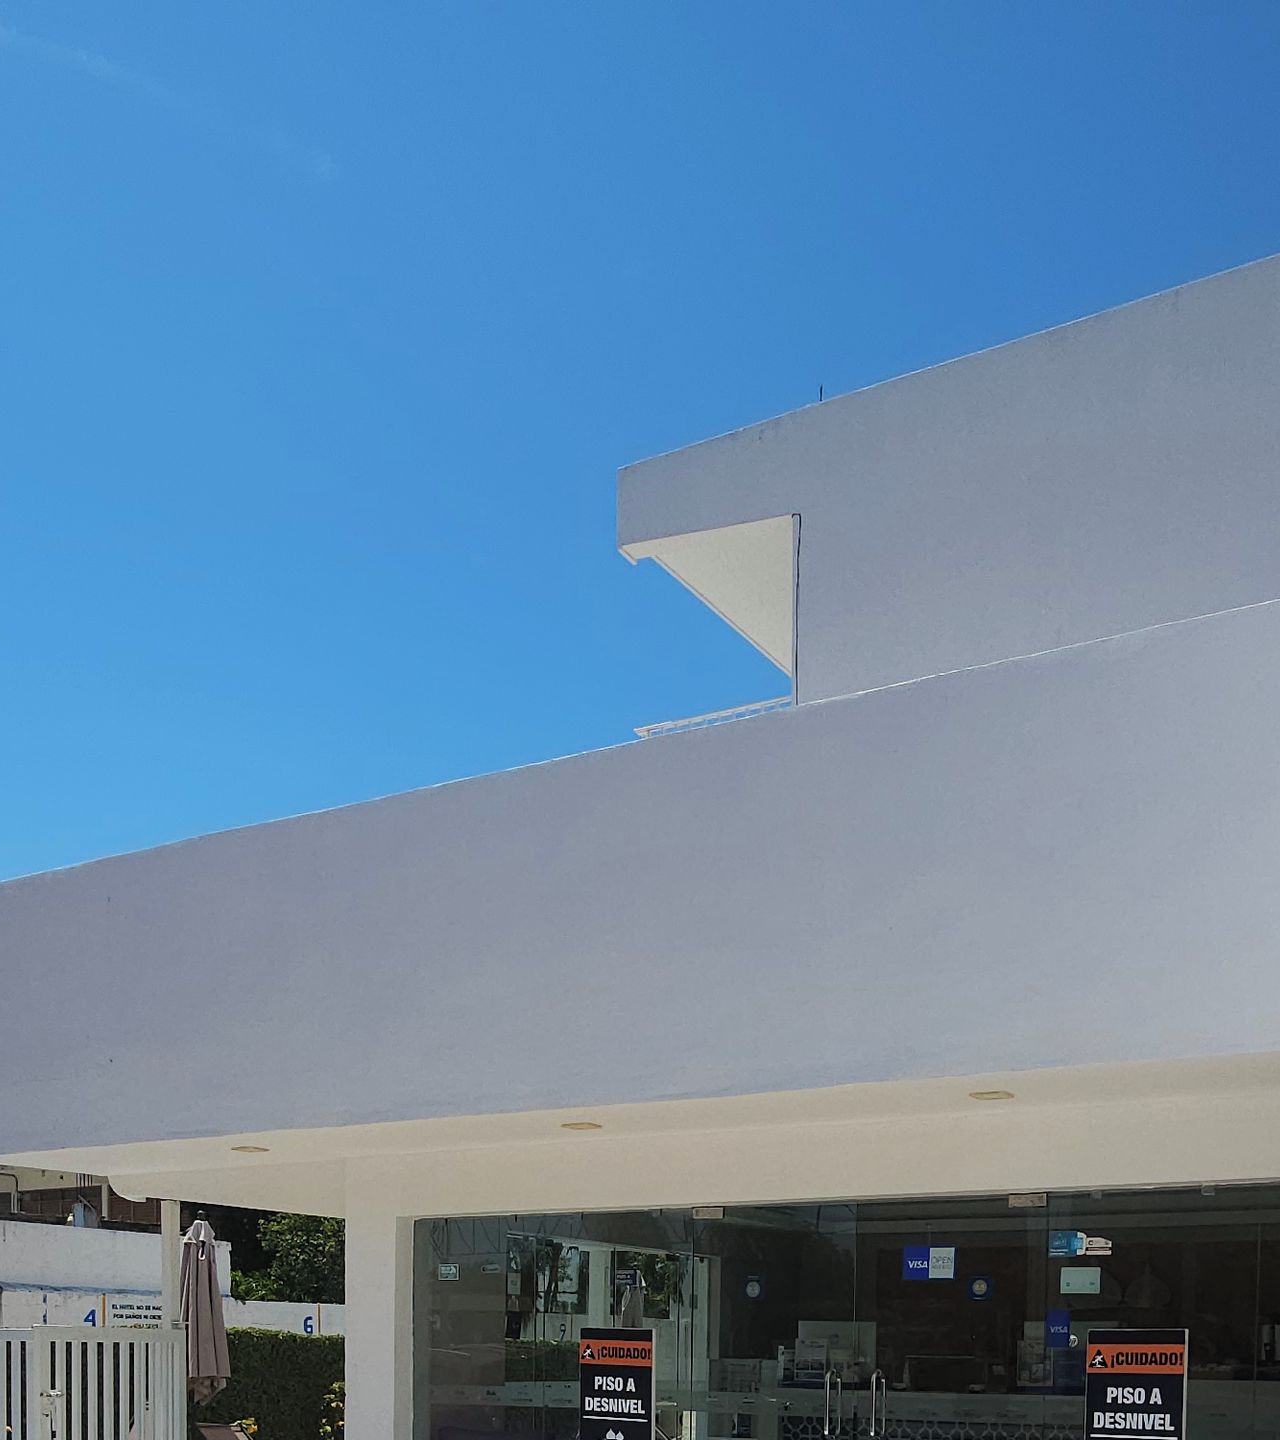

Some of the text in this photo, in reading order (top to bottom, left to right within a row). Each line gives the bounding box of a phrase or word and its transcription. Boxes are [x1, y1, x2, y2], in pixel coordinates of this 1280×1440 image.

[908, 1260, 928, 1269] VISA
[83, 1309, 97, 1328] 4
[303, 1316, 313, 1335] 6
[1049, 1326, 1068, 1334] VISA
[597, 1346, 651, 1360] ¡CUIDADO!
[1110, 1351, 1184, 1368] ¡CUIDADO!
[594, 1376, 636, 1393] PISO A
[1106, 1386, 1163, 1405] PISO A
[584, 1396, 646, 1415] DESNIVEL
[1093, 1411, 1176, 1431] DESNIVEL
